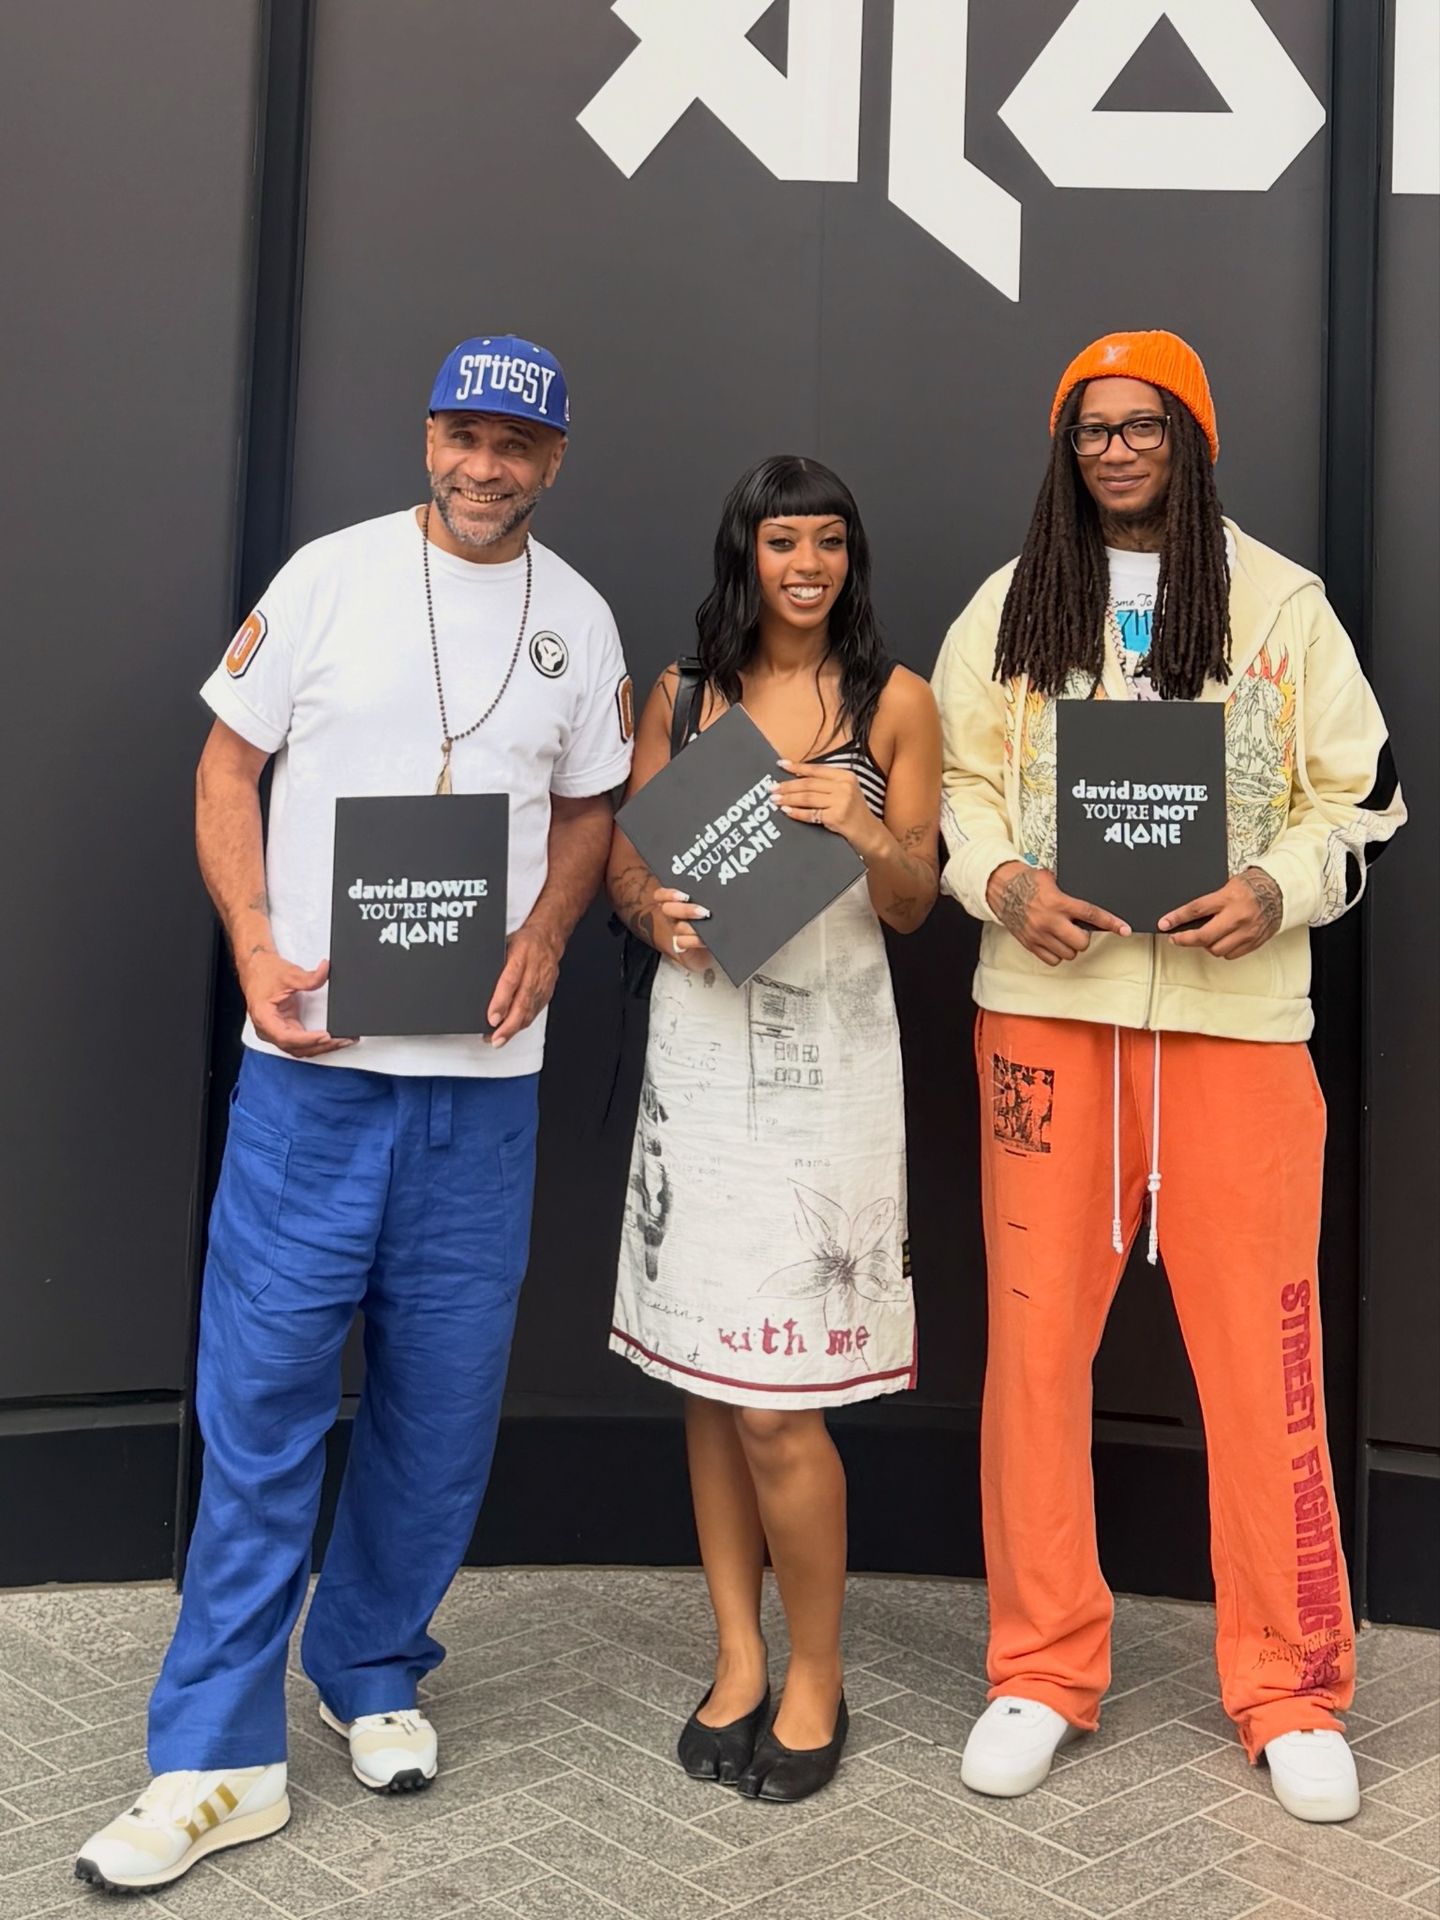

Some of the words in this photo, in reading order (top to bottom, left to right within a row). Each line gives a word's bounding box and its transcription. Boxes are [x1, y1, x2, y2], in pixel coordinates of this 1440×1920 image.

[1072, 778, 1130, 801] david
[1132, 783, 1209, 802] BOWIE
[1082, 803, 1150, 820] YOU'RE
[1153, 804, 1199, 821] NOT
[671, 823, 719, 875] david
[717, 820, 782, 885] ALONE
[1103, 822, 1181, 850] ALONE
[687, 828, 745, 882] YOU'RE
[348, 877, 408, 900] david
[410, 878, 488, 899] BOWIE
[358, 902, 428, 920] YOU'RE
[431, 900, 478, 919] NOT
[378, 920, 459, 951] ALONE
[718, 1317, 808, 1356] with
[825, 1325, 871, 1356] me
[1281, 1278, 1316, 1434] STREET
[1292, 1444, 1343, 1636] FIGHTING
